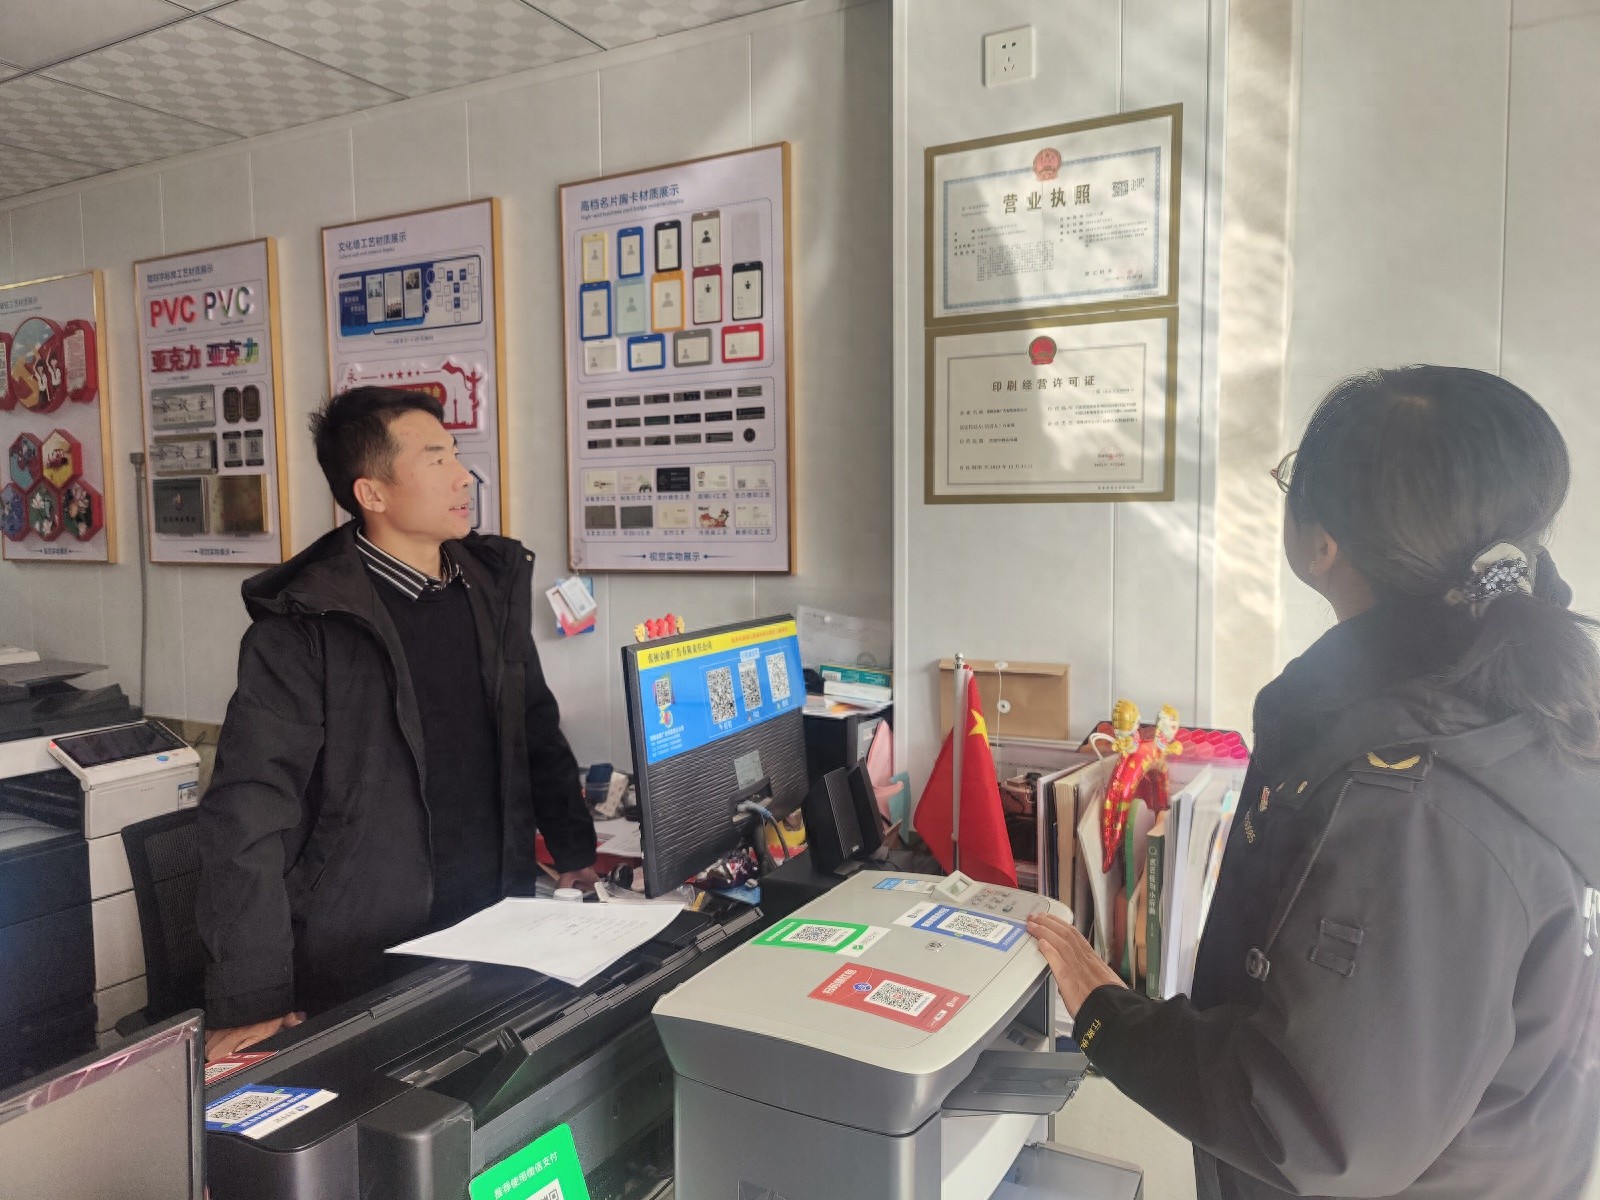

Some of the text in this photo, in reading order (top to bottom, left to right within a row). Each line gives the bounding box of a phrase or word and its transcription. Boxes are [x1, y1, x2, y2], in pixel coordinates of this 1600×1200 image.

[580, 183, 680, 212] 高档名片胸卡材质展示
[1003, 184, 1091, 214] 营业执照
[150, 295, 196, 328] PVC
[204, 286, 253, 320] PVC
[151, 345, 202, 373] 亚克力
[206, 337, 259, 367] 亚克力
[992, 375, 1096, 393] 印刷经营许可证
[649, 552, 701, 561] 视觉实物展示
[494, 1151, 558, 1200] 推荐使用微信支付
